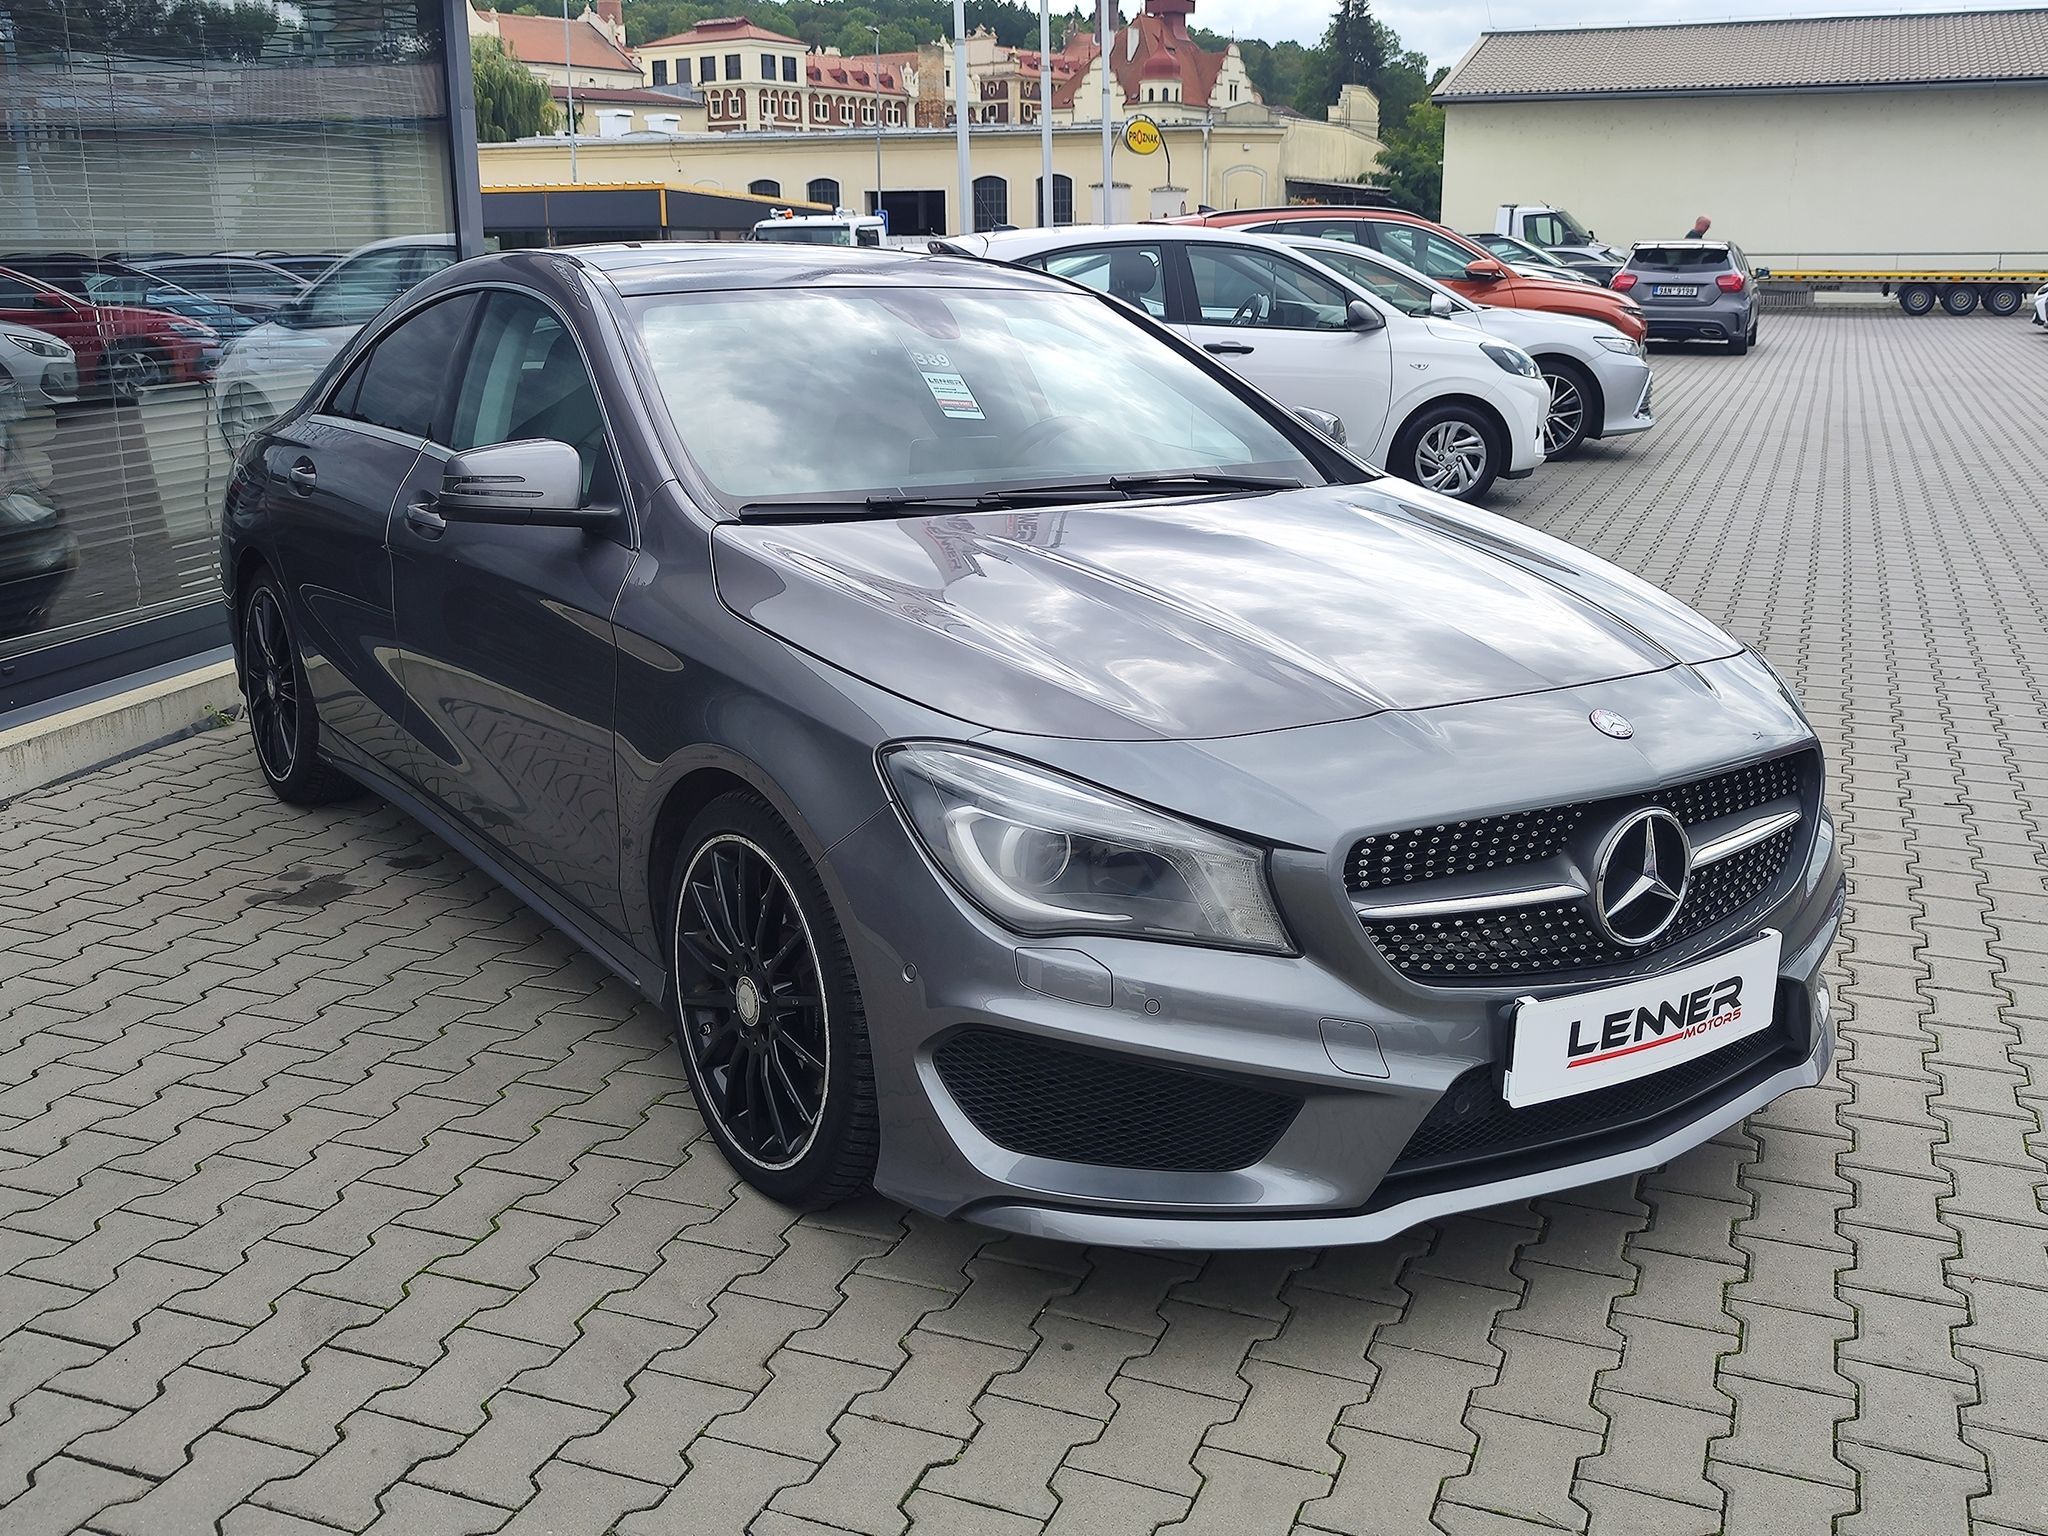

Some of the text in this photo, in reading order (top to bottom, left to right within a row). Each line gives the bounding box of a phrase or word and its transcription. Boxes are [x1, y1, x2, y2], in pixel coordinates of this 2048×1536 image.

[1129, 129, 1158, 144] PROZNAK
[912, 352, 950, 367] 389
[1567, 975, 1744, 1058] LENNER
[1683, 1007, 1742, 1040] MOTORS
